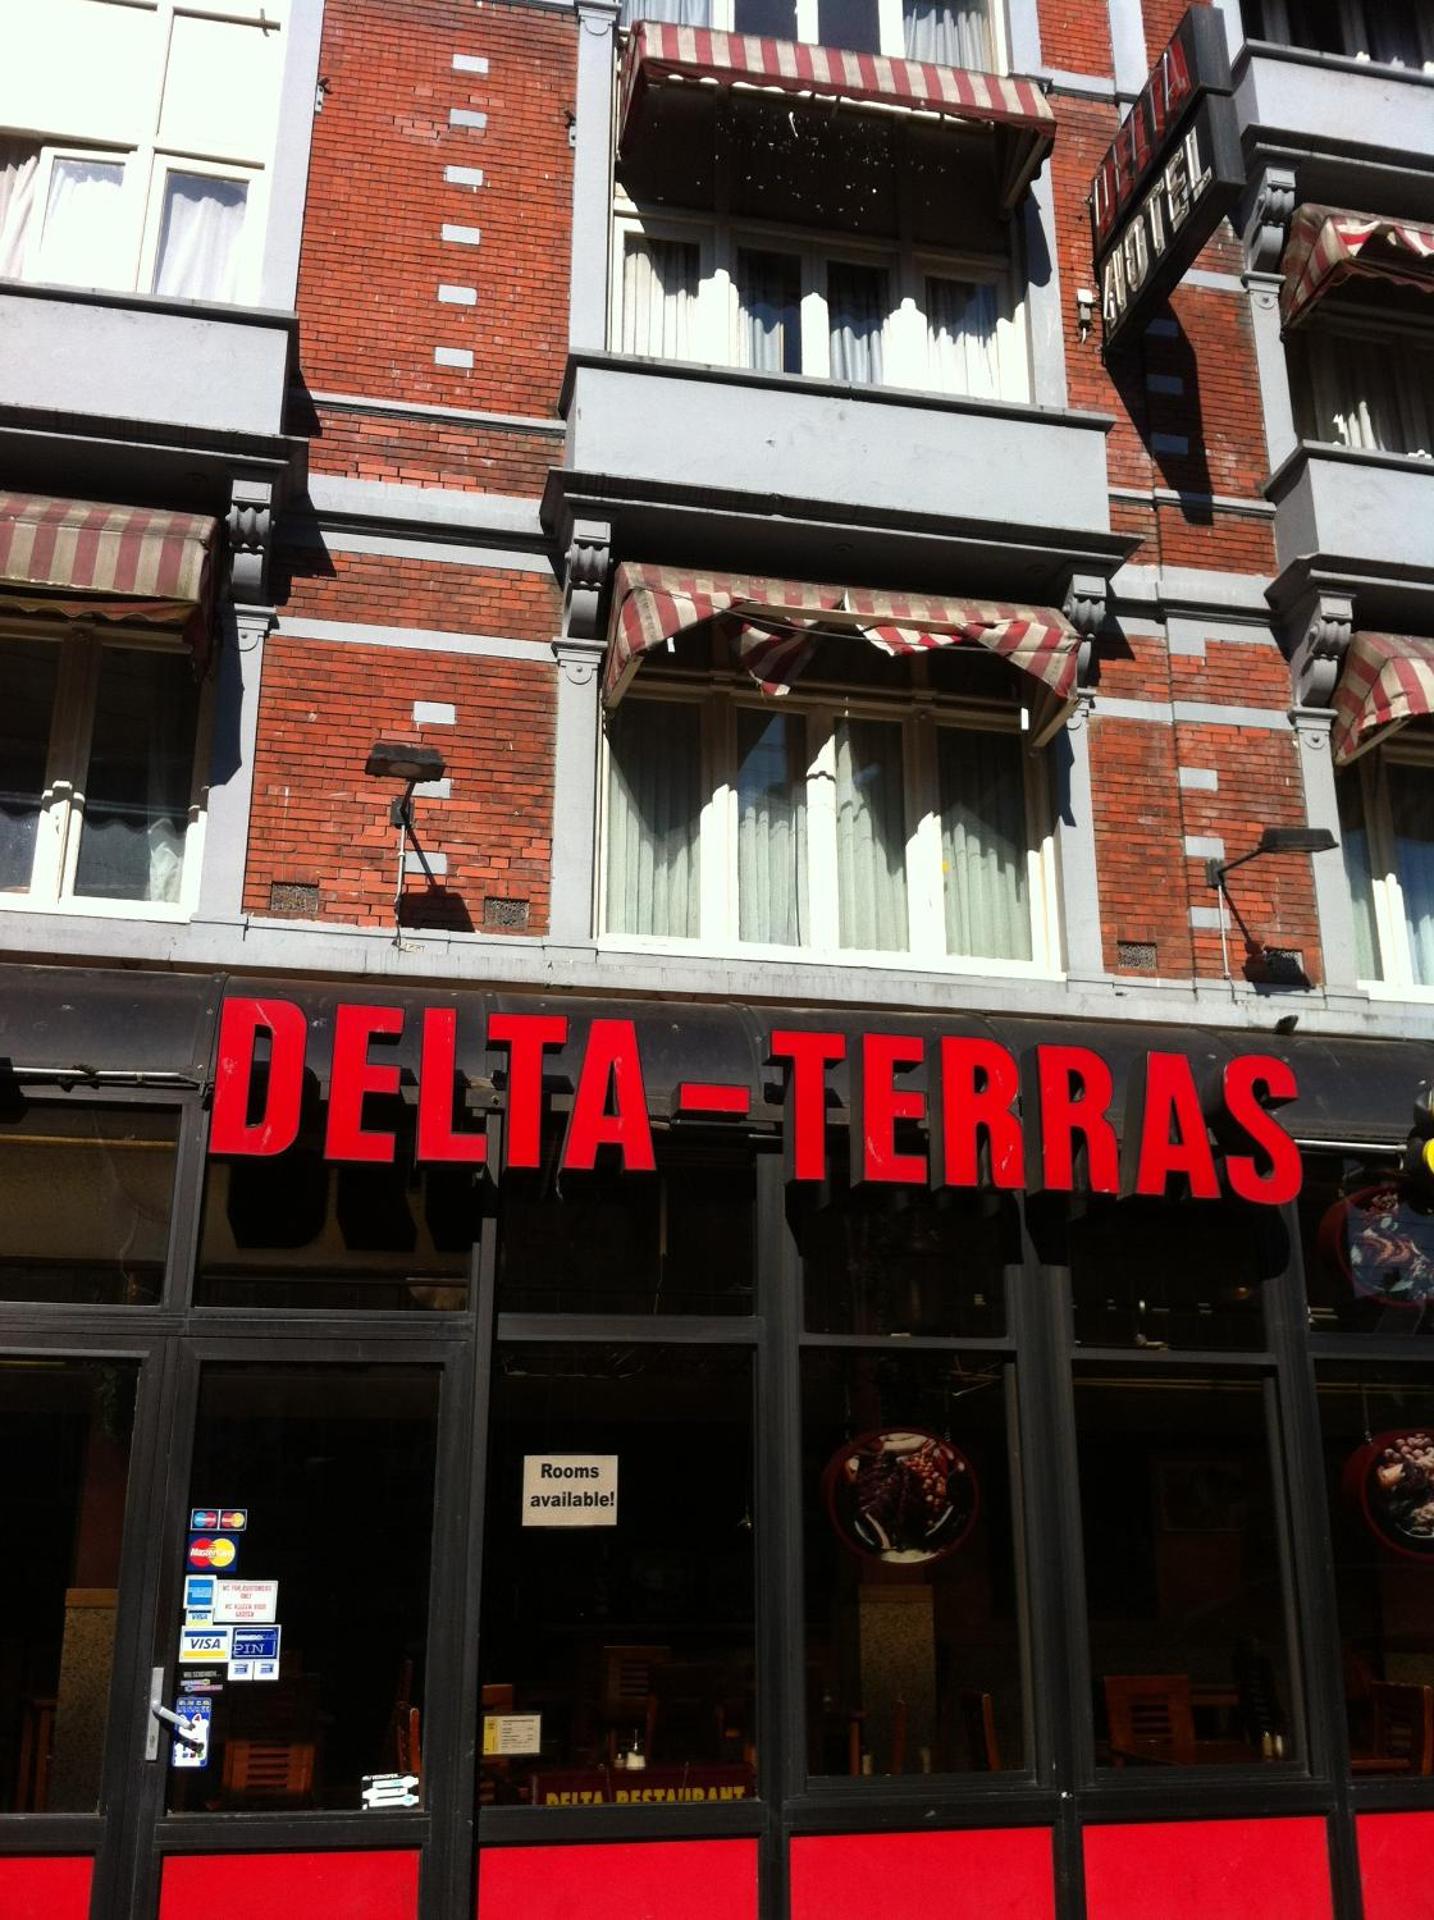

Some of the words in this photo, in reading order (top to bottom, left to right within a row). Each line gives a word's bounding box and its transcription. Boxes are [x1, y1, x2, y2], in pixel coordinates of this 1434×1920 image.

[1093, 36, 1192, 238] DELTA
[1102, 126, 1212, 332] HOTEL
[541, 1463, 599, 1479] Rooms
[530, 1491, 614, 1507] available!
[190, 1638, 222, 1649] VISA
[233, 1643, 265, 1654] PIN
